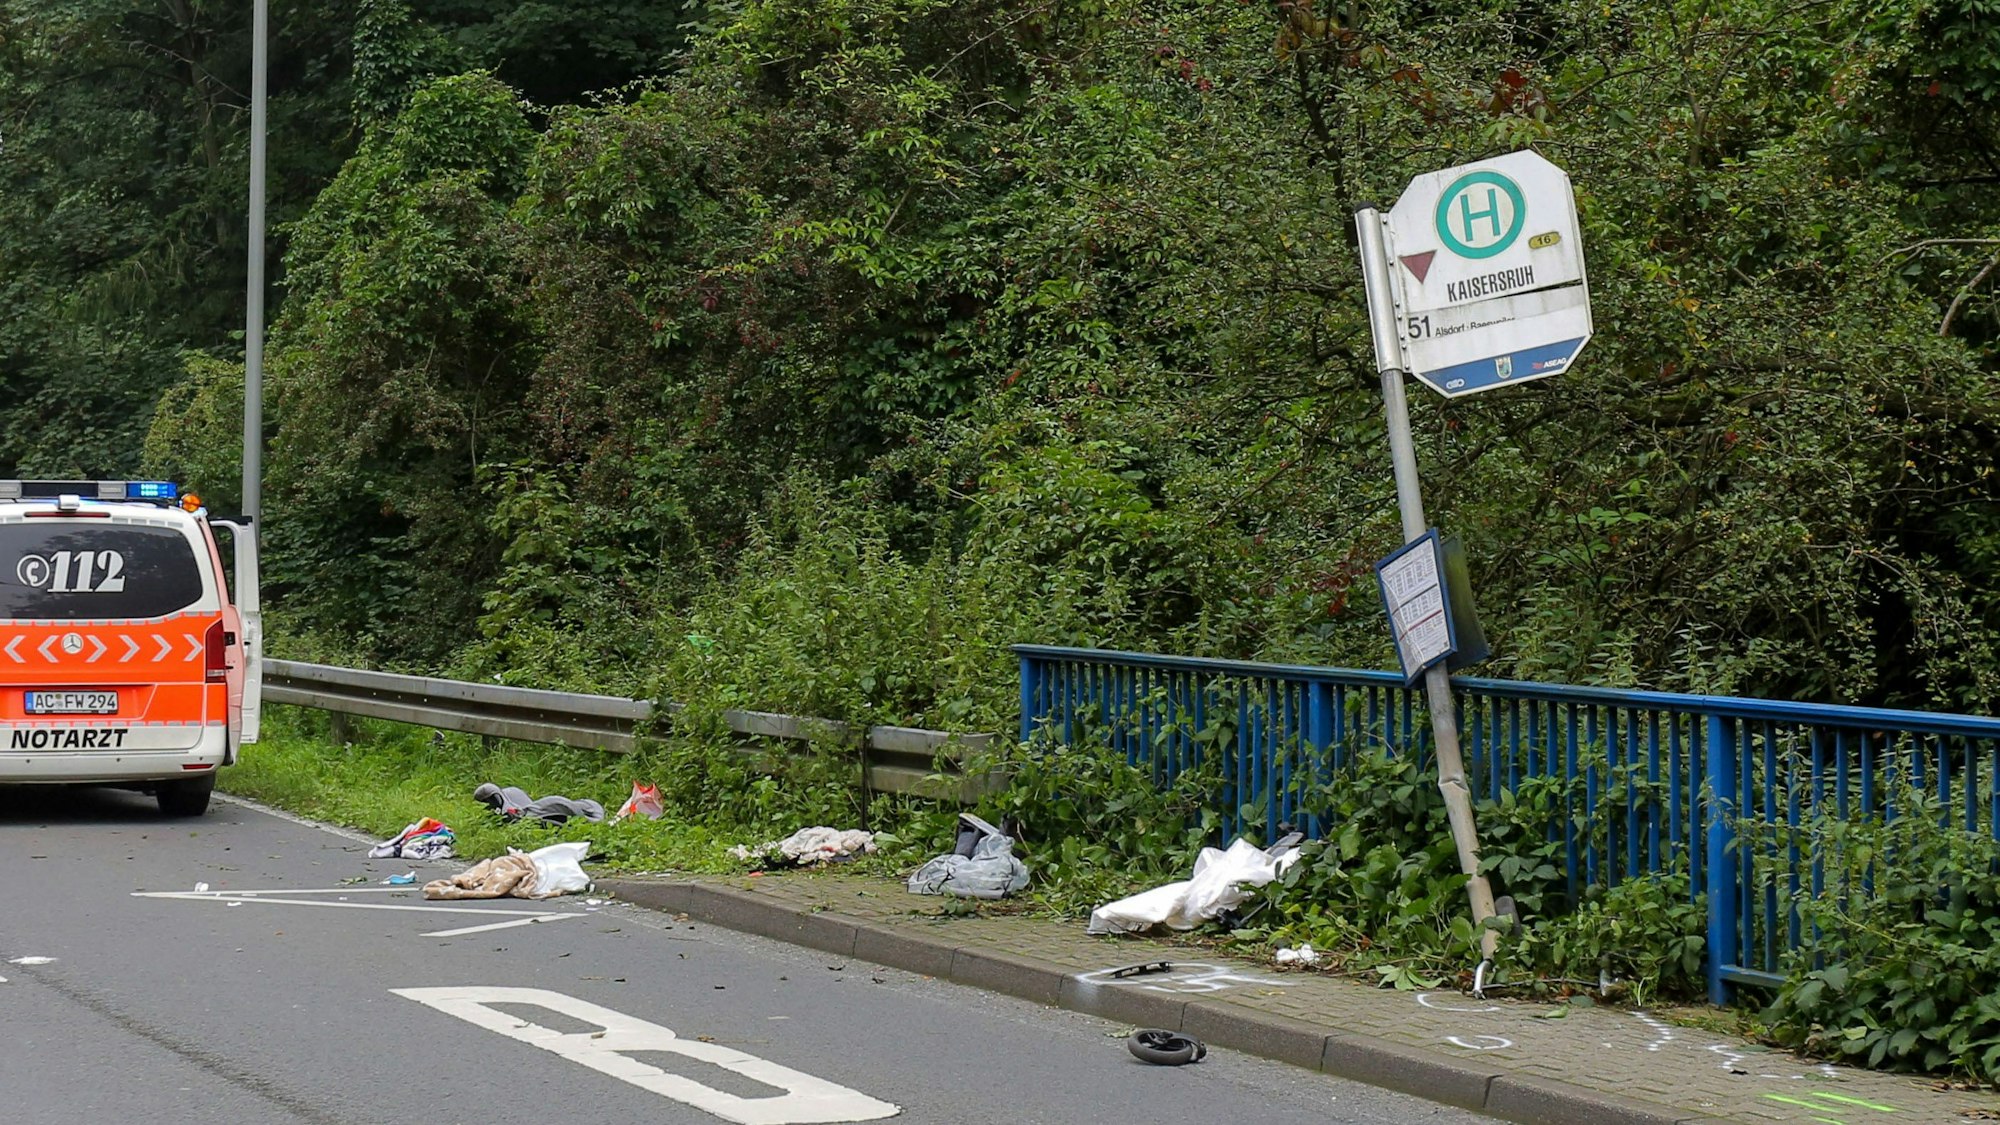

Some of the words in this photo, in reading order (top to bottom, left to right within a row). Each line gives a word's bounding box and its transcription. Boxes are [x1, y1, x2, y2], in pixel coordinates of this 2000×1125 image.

[1460, 188, 1500, 242] H
[1537, 235, 1551, 245] 16
[1447, 265, 1535, 302] KAISERSRUH
[1408, 315, 1431, 339] 51
[1435, 323, 1465, 337] Alsdorf
[47, 549, 126, 593] 112
[35, 694, 54, 709] AC
[65, 694, 84, 709] FW
[88, 694, 116, 709] 294
[11, 728, 128, 749] NOTARZT
